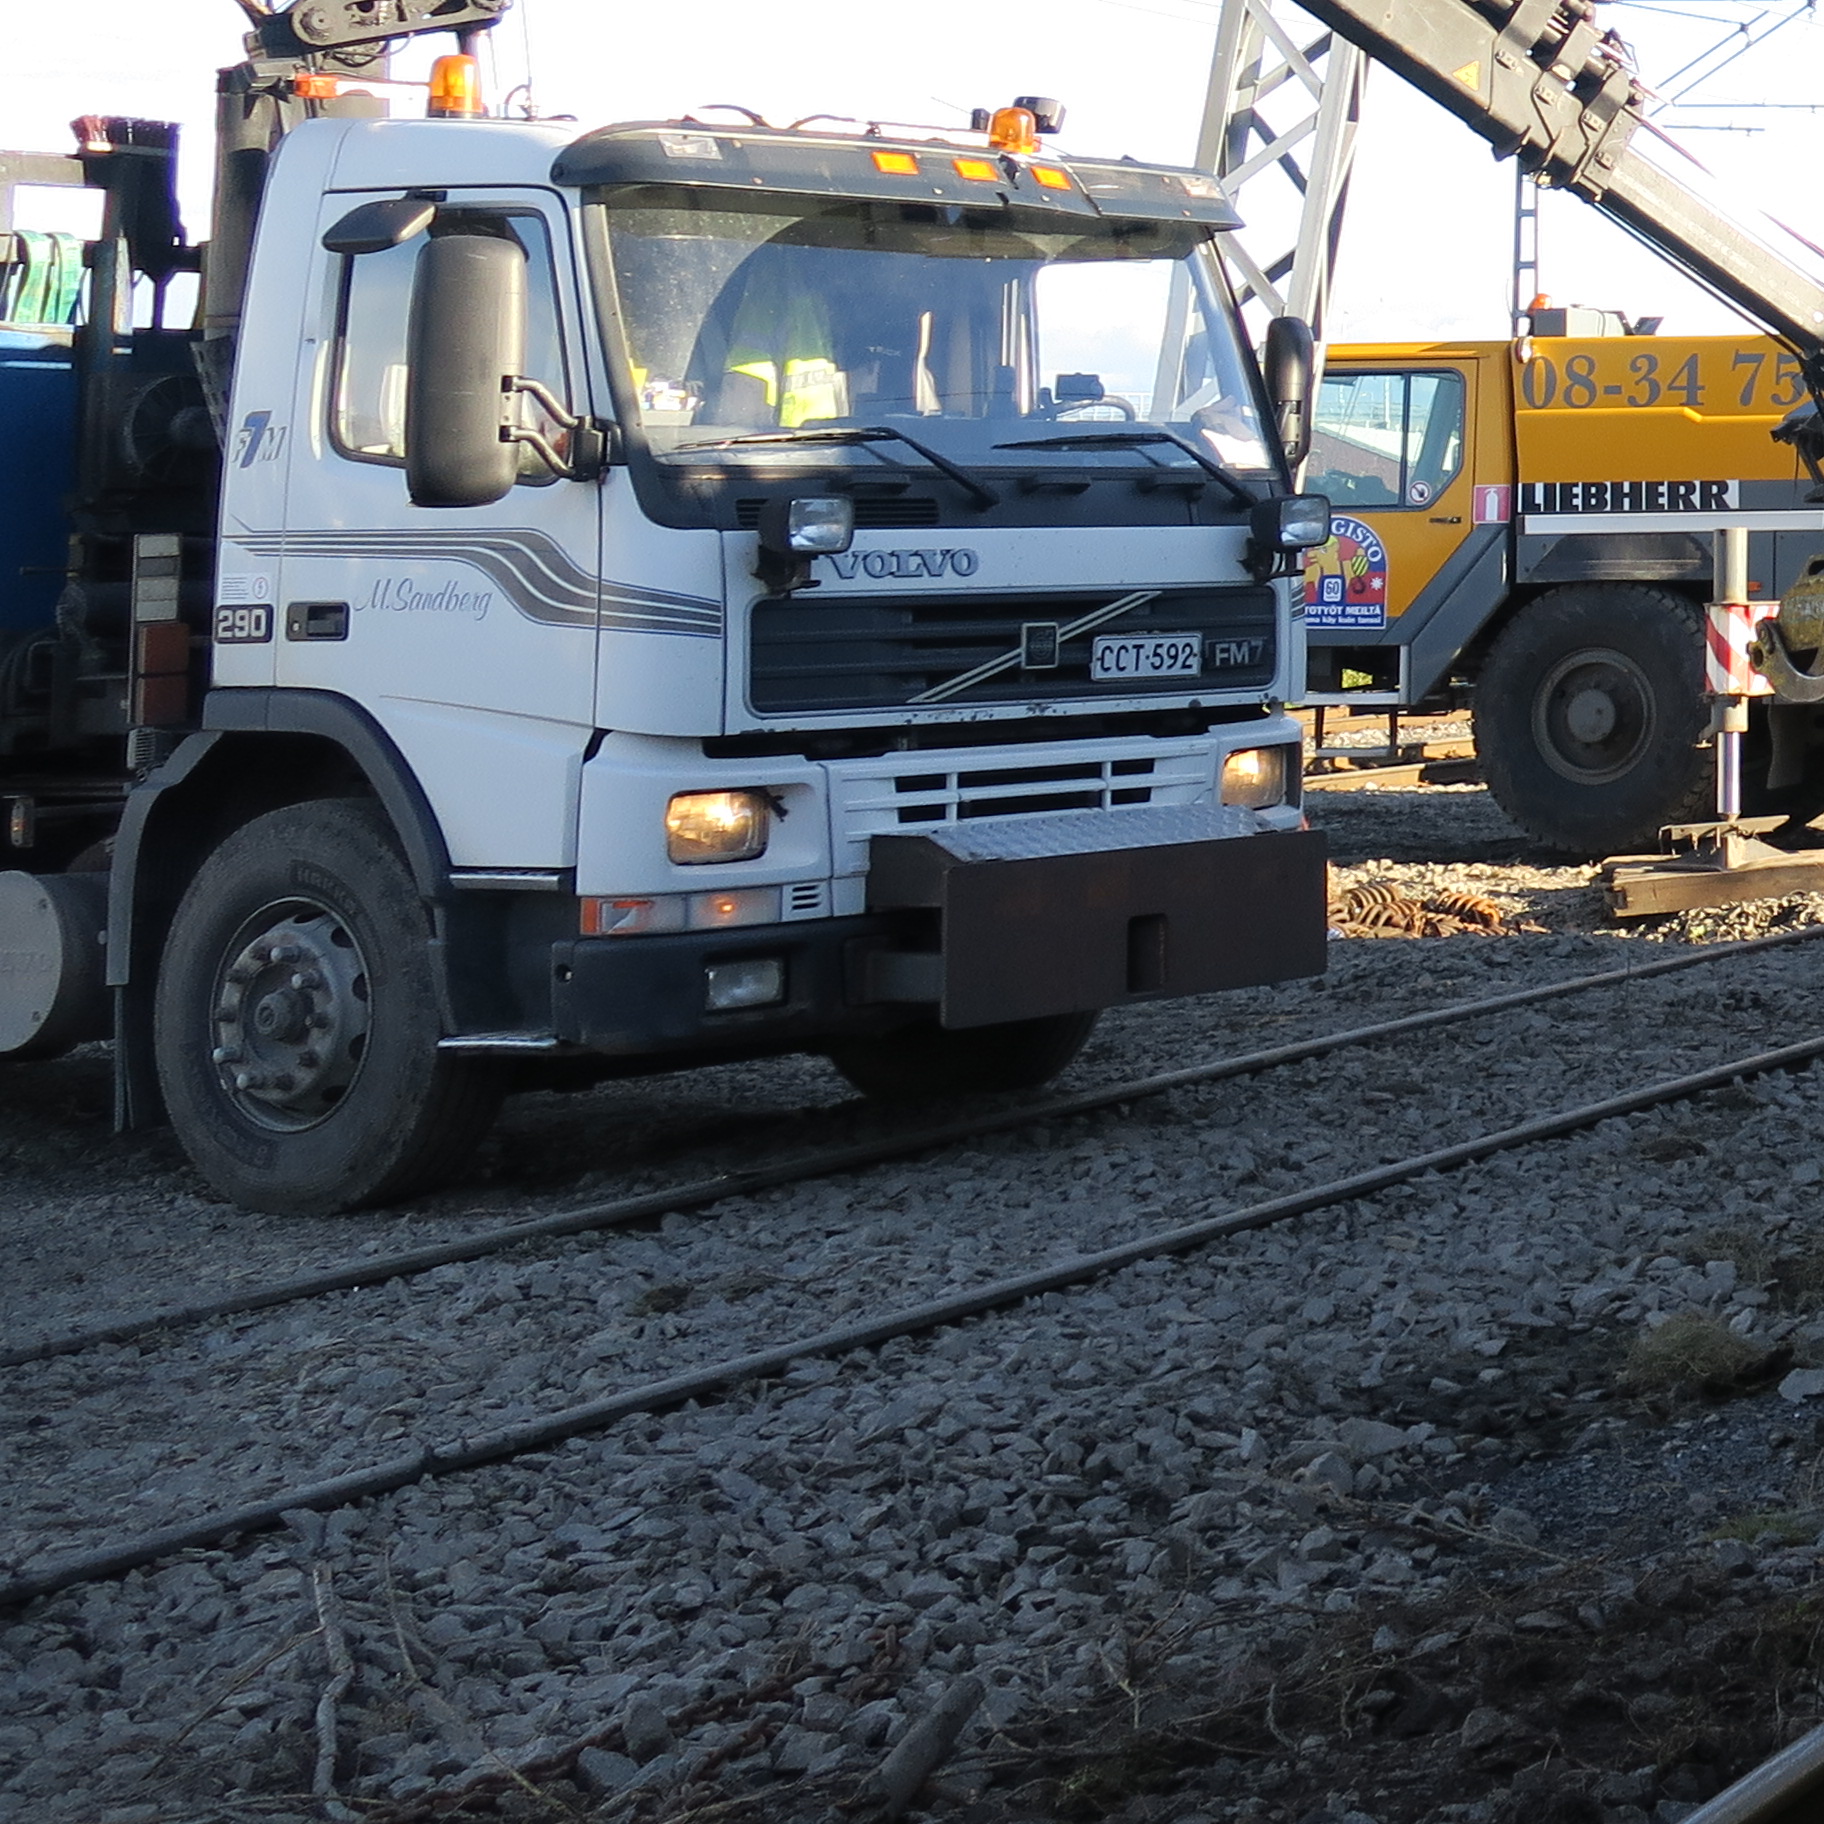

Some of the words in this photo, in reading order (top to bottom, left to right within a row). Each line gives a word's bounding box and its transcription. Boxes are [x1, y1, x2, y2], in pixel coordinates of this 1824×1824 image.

[1522, 353, 1705, 409] 08-34
[1521, 480, 1730, 512] LIEBHERR
[1331, 519, 1382, 562] GISTO
[827, 548, 979, 579] VOLVO
[1325, 581, 1340, 595] 60
[217, 609, 267, 638] 290
[1101, 642, 1194, 672] CCT-592
[1215, 641, 1265, 666] FM7
